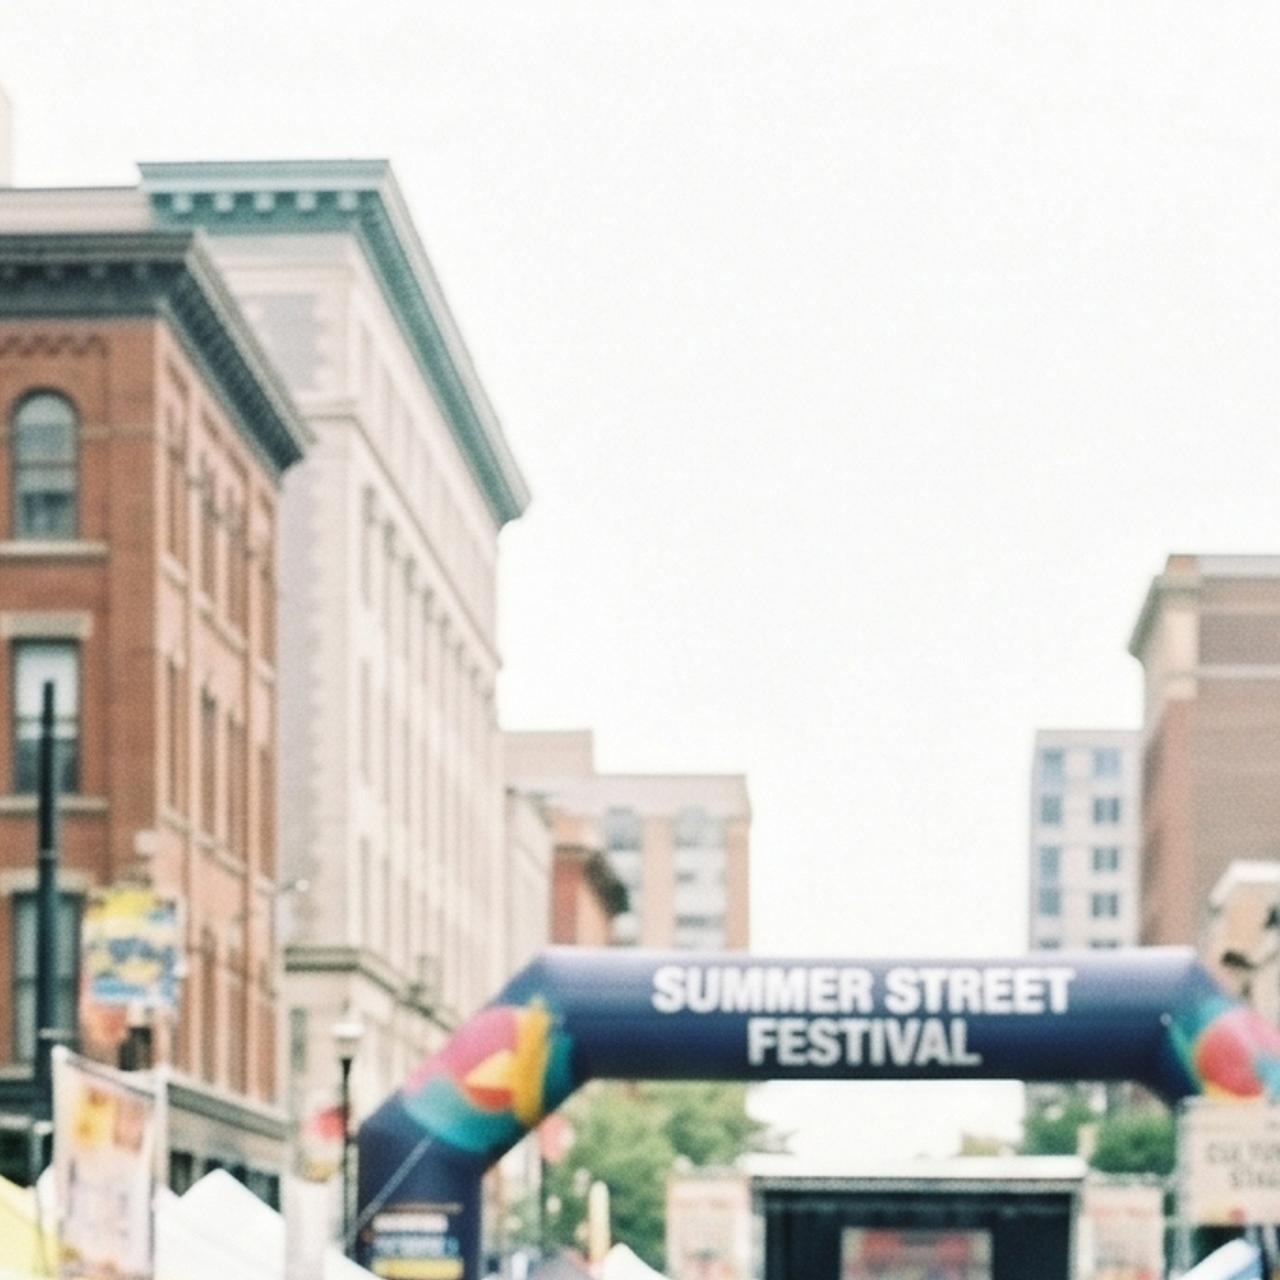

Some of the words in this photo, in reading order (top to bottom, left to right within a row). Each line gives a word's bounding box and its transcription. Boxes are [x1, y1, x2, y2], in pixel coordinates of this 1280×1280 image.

[651, 965, 875, 1014] SUMMER
[884, 967, 1077, 1015] STREET
[746, 1016, 984, 1067] FESTIVAL
